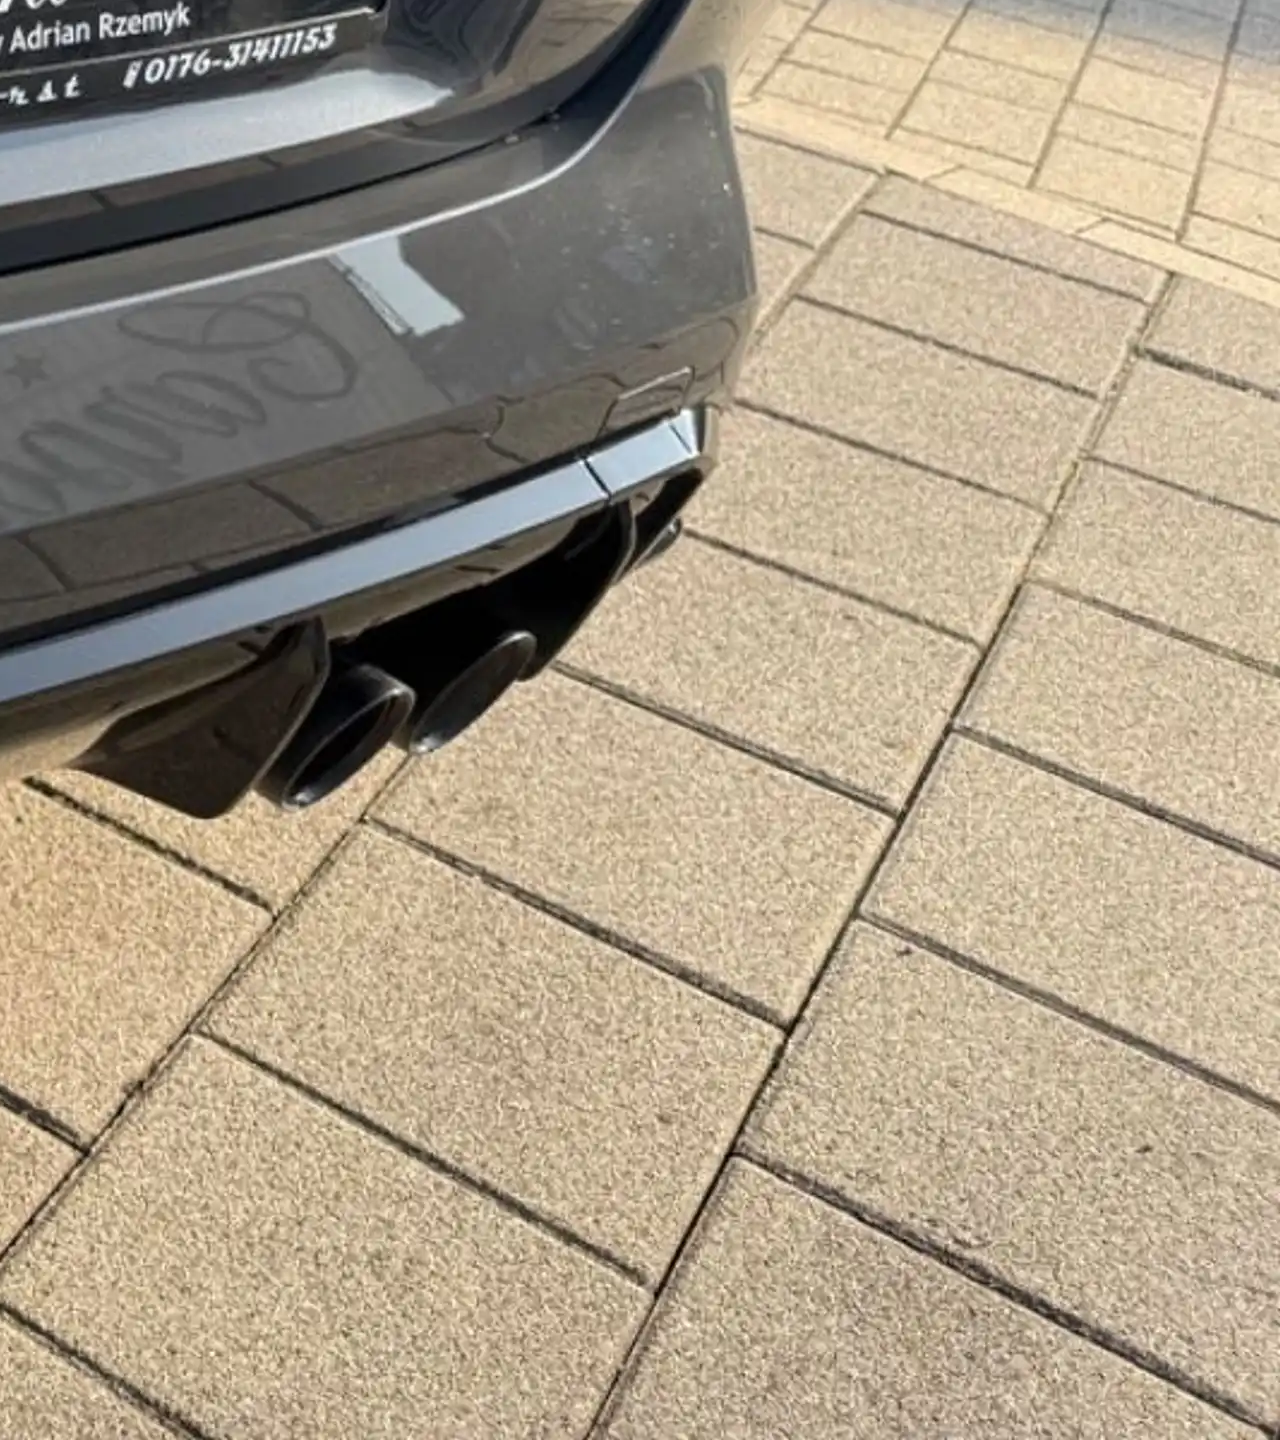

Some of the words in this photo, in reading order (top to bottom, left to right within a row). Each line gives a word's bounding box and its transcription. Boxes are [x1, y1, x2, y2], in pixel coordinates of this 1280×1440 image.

[9, 19, 91, 55] Adrian
[99, 0, 191, 40] Rzemyk
[143, 22, 338, 84] 0176-31411153
